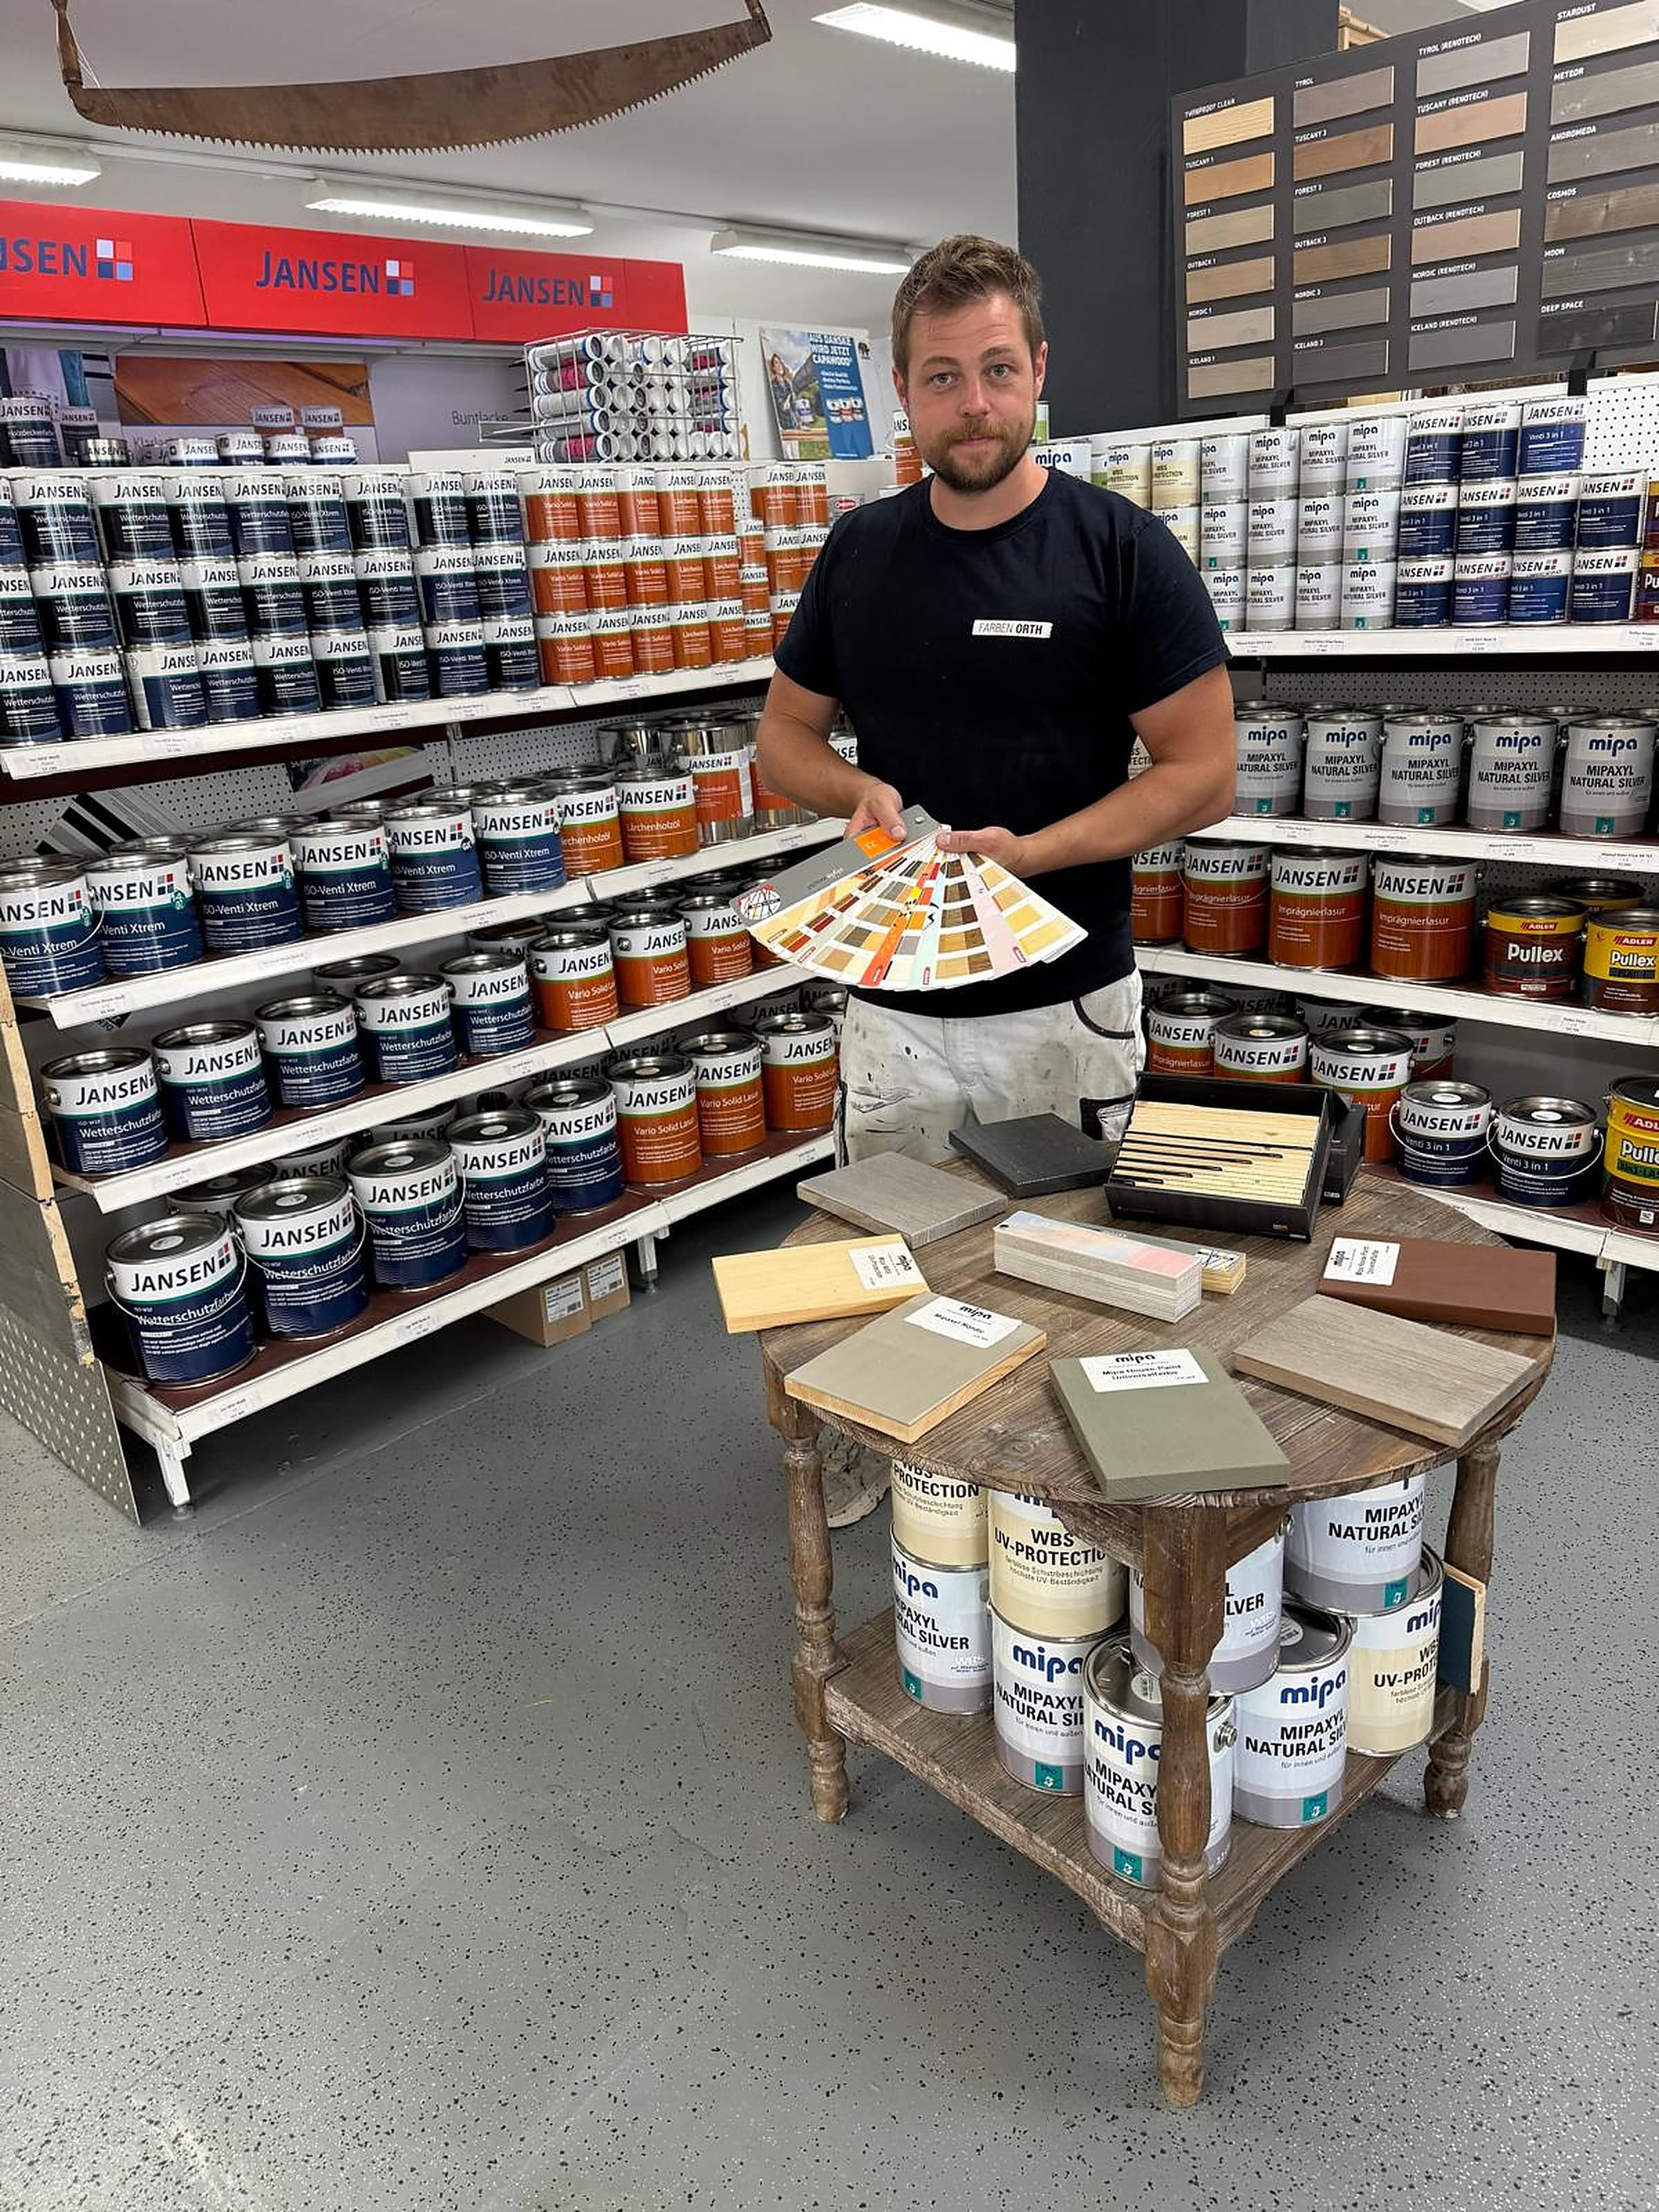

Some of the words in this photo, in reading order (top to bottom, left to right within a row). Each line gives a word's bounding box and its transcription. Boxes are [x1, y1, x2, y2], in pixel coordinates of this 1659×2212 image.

[1557, 3, 1596, 20] STARDUST
[1418, 46, 1439, 56] TYROL
[1441, 33, 1482, 51] (RENOTECH)
[1554, 67, 1584, 81] METEOR
[1295, 77, 1314, 88] TYROL
[1217, 98, 1235, 110] CLEAR
[1417, 100, 1447, 114] TUSCANY
[1448, 90, 1488, 106] (RENOTECH)
[1295, 132, 1321, 142] TUSCANY
[1550, 125, 1596, 141] ANDROMEDA
[1185, 160, 1209, 169] TUSCANY
[1416, 158, 1441, 170] FOREST
[1442, 150, 1481, 164] (RENOTECH)
[1295, 186, 1317, 196] FOREST
[1547, 187, 1577, 200] COSMOS
[1186, 210, 1206, 219] FOREST
[1414, 214, 1444, 226] OUTBACK
[1446, 205, 1485, 219] (RENOTECH)
[1295, 238, 1321, 249] OUTBACK
[0, 237, 87, 277] SEN
[1544, 248, 1565, 257] MOON
[256, 251, 379, 293] JANSEN
[1188, 260, 1212, 269] OUTBACK
[1412, 270, 1436, 279] NORDIC
[1438, 262, 1476, 275] (RENOTECH)
[483, 270, 584, 306] JANSEN
[1295, 290, 1316, 299] NORDIC
[1541, 303, 1560, 313] DEEP
[1562, 300, 1584, 310] SPACE
[1411, 321, 1438, 332] ICELAND
[1439, 316, 1477, 328] (RENOTECH)
[1295, 341, 1318, 350] ICELAND
[2, 404, 44, 416] JANSEN
[1528, 406, 1573, 420] JANSEN
[1309, 430, 1335, 445] mipa
[1353, 424, 1378, 439] mipa
[1255, 436, 1280, 450] mipa
[1035, 449, 1071, 467] mipa
[30, 485, 80, 498] JANSEN
[114, 484, 162, 498] JANSEN
[235, 482, 281, 497] JANSEN
[286, 483, 330, 497] JANSEN
[1353, 498, 1379, 512] mipa
[1213, 574, 1239, 587] mipa
[1350, 567, 1376, 581] mipa
[50, 575, 100, 589] JANSEN
[632, 612, 668, 626] JANSEN
[979, 623, 1014, 633] FARBEN
[1016, 624, 1042, 635] ORTH
[437, 631, 478, 644] JANSEN
[203, 650, 249, 665] JANSEN
[68, 664, 117, 678] JANSEN
[1248, 725, 1287, 746] mipa
[1327, 727, 1367, 747] mipa
[1409, 730, 1451, 751] mipa
[1496, 731, 1541, 753] mipa
[1589, 734, 1638, 757] mipa
[1247, 753, 1286, 762] MIPAXYL
[1325, 755, 1366, 765] MIPAXYL
[1408, 759, 1449, 769] MIPAXYL
[1312, 765, 1350, 776] NATURAL
[1494, 761, 1538, 771] MIPAXYL
[1586, 765, 1634, 776] MIPAXYL
[1391, 770, 1434, 780] NATURAL
[1478, 771, 1521, 783] NATURAL
[1571, 776, 1615, 788] NATURAL
[1618, 776, 1644, 787] SILVER
[621, 789, 674, 805] JANSEN
[484, 814, 542, 831] JANSEN
[301, 843, 366, 863] JANSEN
[524, 847, 550, 857] Xtrem
[200, 861, 268, 881] JANSEN
[427, 863, 456, 874] Xtrem
[1187, 855, 1245, 873] JANSEN
[1276, 865, 1341, 887] JANSEN
[1378, 872, 1444, 894] JANSEN
[346, 880, 376, 893] Xtrem
[247, 900, 279, 913] Xtrem
[131, 921, 165, 933] Xtrem
[711, 945, 731, 955] Vario
[1508, 943, 1564, 962] Pullex
[559, 951, 610, 974] JANSEN
[1611, 950, 1656, 967] Pullex
[653, 963, 671, 975] Vario
[468, 975, 524, 998] JANSEN
[568, 989, 590, 1000] Vario
[377, 1000, 441, 1023] JANSEN
[277, 1021, 344, 1046] JANSEN
[1151, 1020, 1205, 1041] JANSEN
[185, 1047, 253, 1075] JANSEN
[1219, 1044, 1280, 1065] JANSEN
[694, 1061, 751, 1082] JANSEN
[1314, 1057, 1375, 1081] JANSEN
[793, 1074, 813, 1084] Vario
[75, 1076, 148, 1105] JANSEN
[626, 1085, 687, 1107] JANSEN
[700, 1098, 721, 1107] Vario
[722, 1095, 742, 1106] Solid
[1403, 1109, 1462, 1132] JANSEN
[1634, 1118, 1659, 1130] ADL
[635, 1125, 655, 1136] Vario
[657, 1121, 678, 1134] Solid
[1501, 1124, 1562, 1150] JANSEN
[1426, 1141, 1432, 1151] 3
[1434, 1141, 1442, 1151] in
[1445, 1142, 1450, 1152] 1
[463, 1147, 531, 1171] JANSEN
[1524, 1159, 1530, 1170] 3
[1532, 1160, 1541, 1170] in
[1544, 1161, 1548, 1172] 1
[368, 1175, 442, 1203] JANSEN
[261, 1214, 340, 1248] JANSEN
[131, 1256, 216, 1293] JANSEN
[960, 1306, 992, 1320] mipa
[1115, 1354, 1156, 1363] mipa
[1031, 1528, 1074, 1547] WBS
[1329, 1522, 1408, 1541] NATURAL
[919, 1630, 969, 1649] SILVER
[1013, 1644, 1084, 1683] mipa
[1280, 1669, 1346, 1709] mipa
[996, 1681, 1058, 1725] NATURAL
[1246, 1736, 1326, 1757] NATURAL
